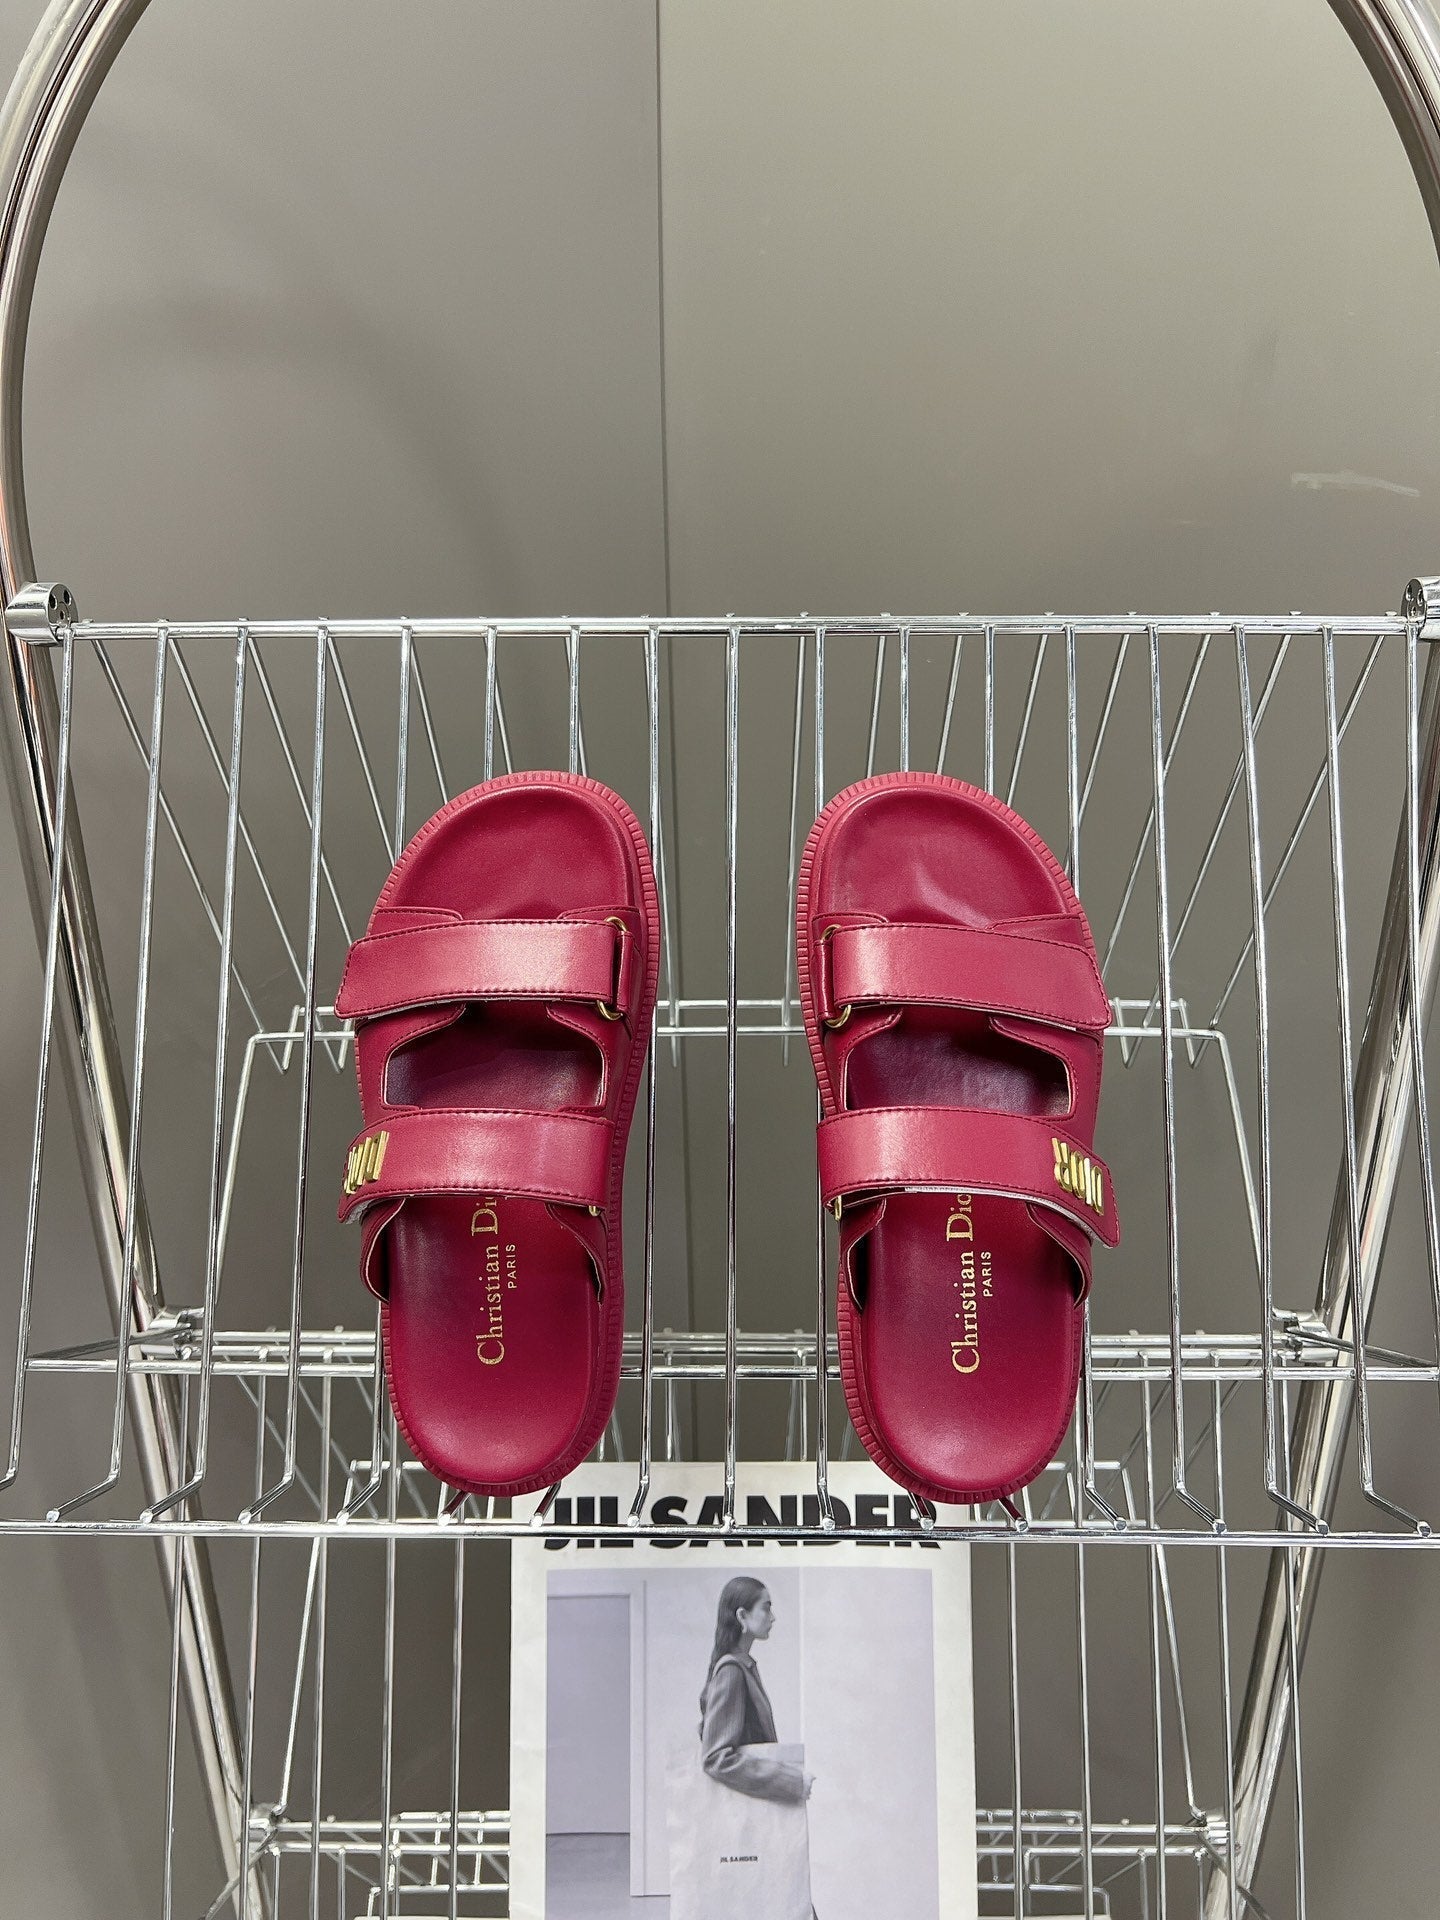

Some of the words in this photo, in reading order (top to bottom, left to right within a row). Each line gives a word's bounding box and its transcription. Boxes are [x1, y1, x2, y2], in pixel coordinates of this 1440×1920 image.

[470, 1196, 500, 1237] Di
[945, 1193, 974, 1242] Dio
[505, 1243, 518, 1290] PARIS
[980, 1251, 994, 1297] PARIS
[475, 1244, 505, 1366] Christian
[950, 1250, 980, 1374] Christian
[543, 1495, 634, 1550] JIL
[649, 1494, 942, 1550] SANDER
